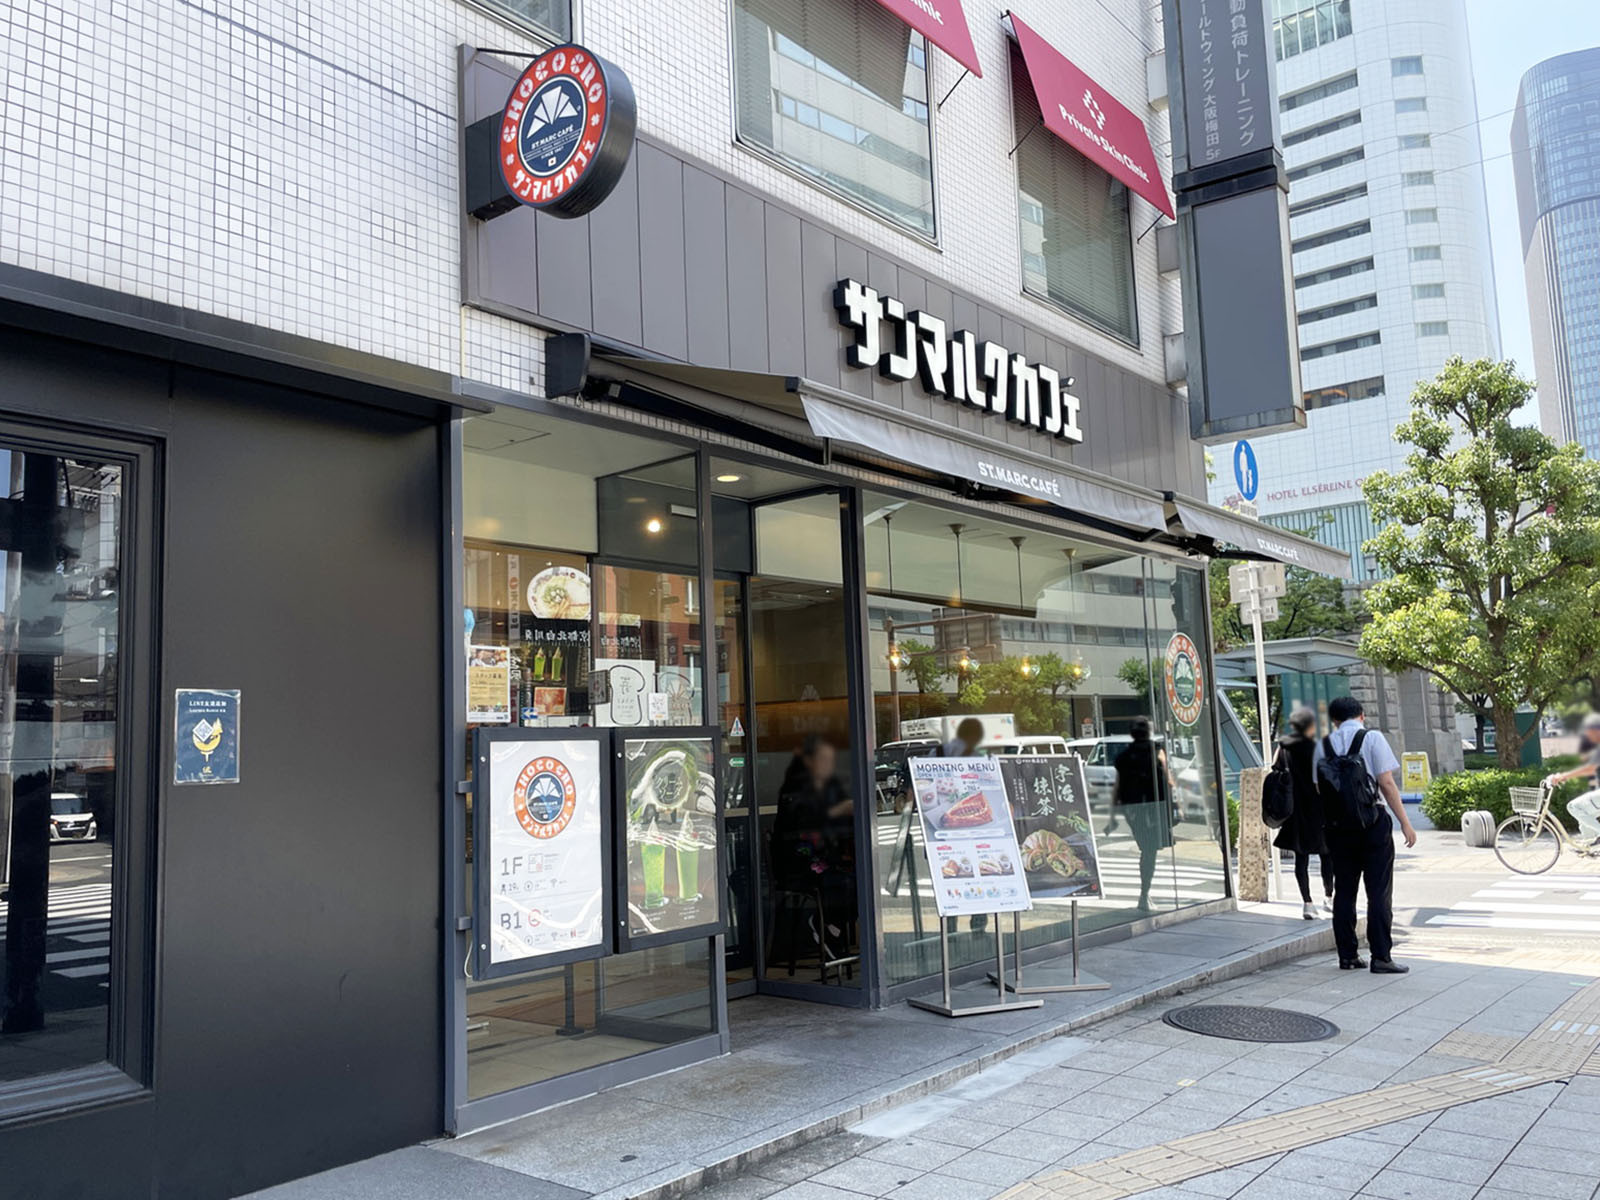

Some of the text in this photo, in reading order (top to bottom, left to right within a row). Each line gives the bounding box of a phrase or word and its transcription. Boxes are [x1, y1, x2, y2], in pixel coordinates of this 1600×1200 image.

[1058, 103, 1150, 183] Private Skin Clinic
[512, 140, 596, 200] サンマルクカフェ
[842, 279, 1083, 443] サンマルクカフェ
[1030, 478, 1061, 498] CAFÉ
[1267, 488, 1298, 502] HOTEL
[916, 762, 996, 773] MORNING MENU
[1031, 776, 1056, 817] 抹茶
[1054, 763, 1075, 804] 宇治
[501, 856, 523, 876] 1F
[500, 911, 522, 930] B1
